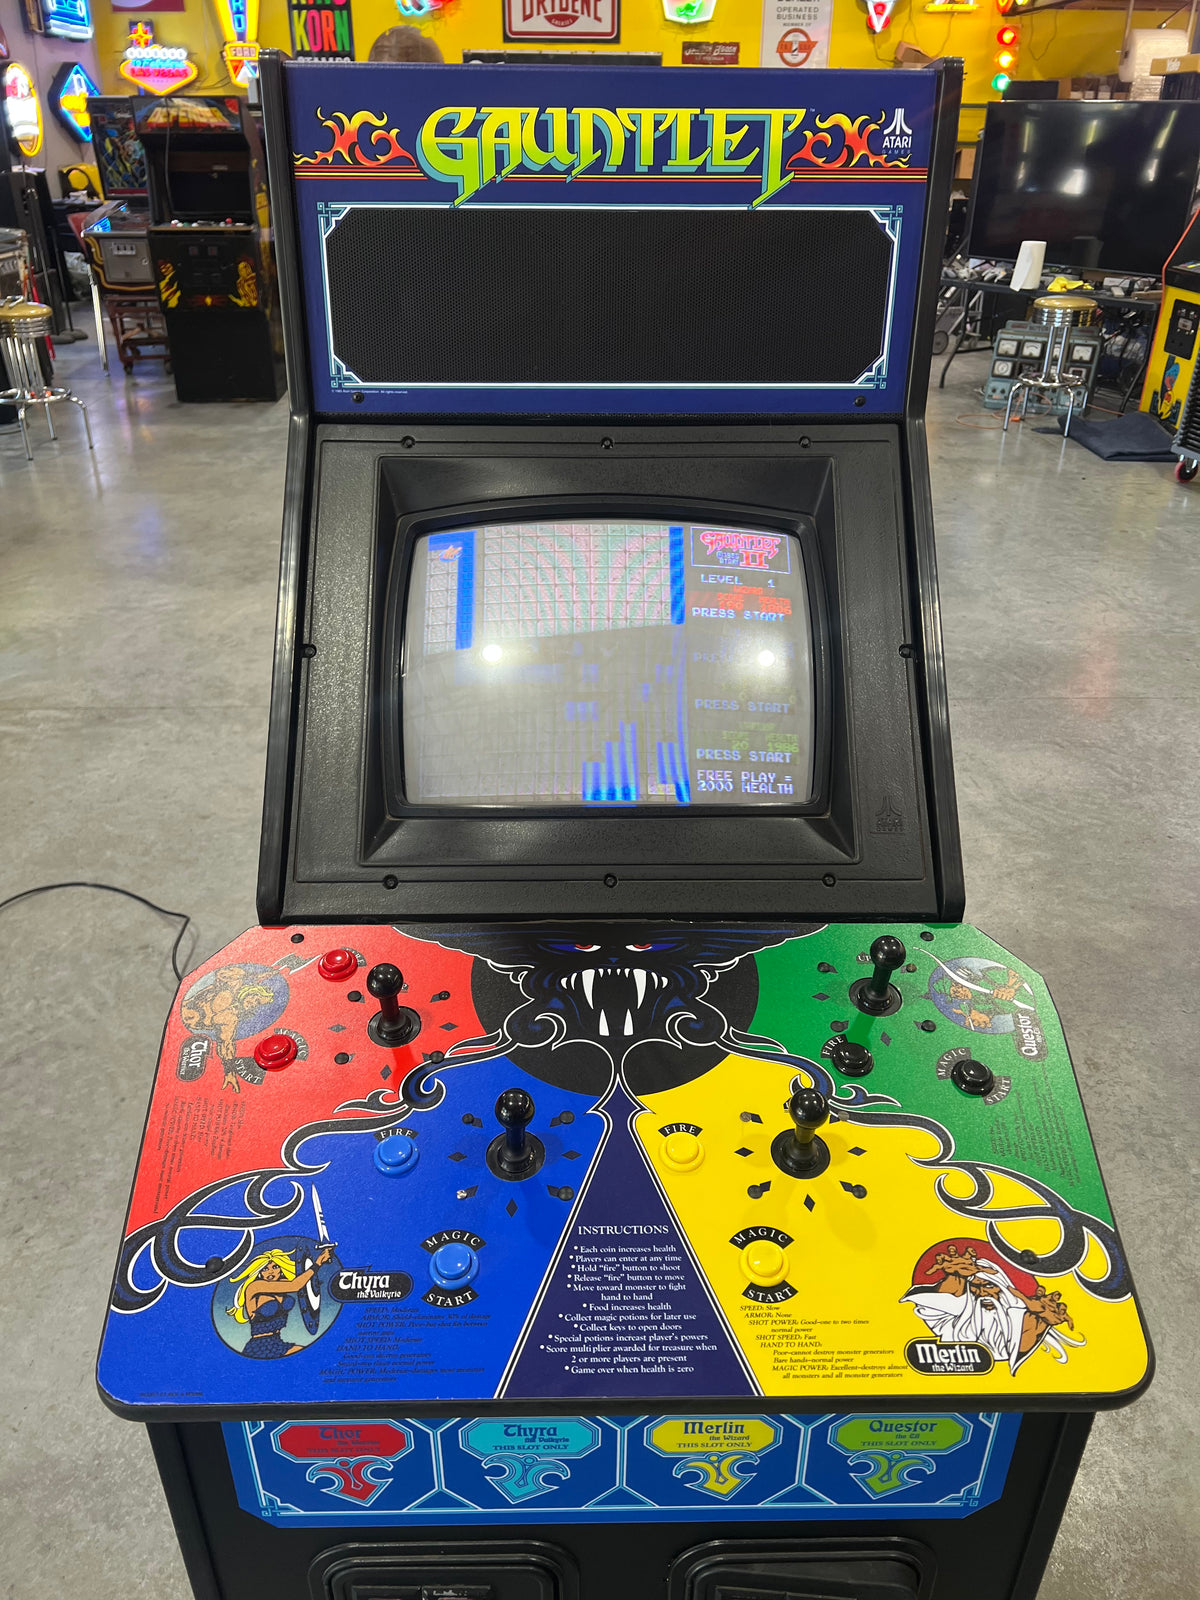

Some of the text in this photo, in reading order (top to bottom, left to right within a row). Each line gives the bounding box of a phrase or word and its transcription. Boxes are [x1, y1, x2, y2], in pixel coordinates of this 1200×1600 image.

[292, 9, 350, 52] KORN
[130, 68, 188, 78] LAS VEGAS
[147, 107, 231, 128] DEFENDER
[882, 136, 912, 148] ATARI
[416, 106, 807, 209] GAUNTLET
[700, 574, 776, 588] LEVEL 1
[692, 607, 785, 622] PRESS START
[695, 698, 790, 713] PRESS START
[696, 748, 792, 763] PRESS START
[697, 769, 733, 781] FREE
[741, 771, 776, 783] PLAY
[697, 780, 794, 795] 2000 HEALTH
[1018, 1013, 1038, 1056] Questor
[822, 1036, 844, 1055] FIRE
[189, 1040, 208, 1068] Thor
[938, 1048, 966, 1076] MAGIC
[235, 1059, 262, 1084] START
[987, 1078, 1011, 1104] START
[380, 1128, 413, 1138] FIRE
[664, 1124, 697, 1134] FIRE
[578, 1225, 669, 1235] INSTRUCTIONS
[734, 1227, 788, 1245] MAGIC
[425, 1231, 481, 1247] MAGIC
[580, 1245, 598, 1253] Each
[576, 1255, 601, 1263] Players
[578, 1264, 596, 1272] Hold
[338, 1272, 390, 1293] Thyra
[669, 1283, 686, 1291] fight
[370, 1290, 401, 1299] Valkyrie
[426, 1291, 473, 1307] START
[747, 1287, 793, 1302] START
[589, 1303, 609, 1311] Food
[594, 1314, 617, 1322] magic
[619, 1314, 648, 1322] potions
[610, 1324, 626, 1332] keys
[554, 1334, 581, 1343] Special
[584, 1334, 613, 1343] potions
[681, 1334, 708, 1342] powers
[614, 1355, 640, 1364] players
[915, 1343, 981, 1363] Merlin
[571, 1365, 596, 1373] Game
[617, 1365, 638, 1373] when
[641, 1365, 666, 1373] health
[932, 1364, 974, 1372] the Wizard
[503, 1424, 557, 1440] Thyra
[684, 1422, 744, 1434] Merlin
[869, 1419, 938, 1433] Questor
[318, 1427, 361, 1440] Thor
